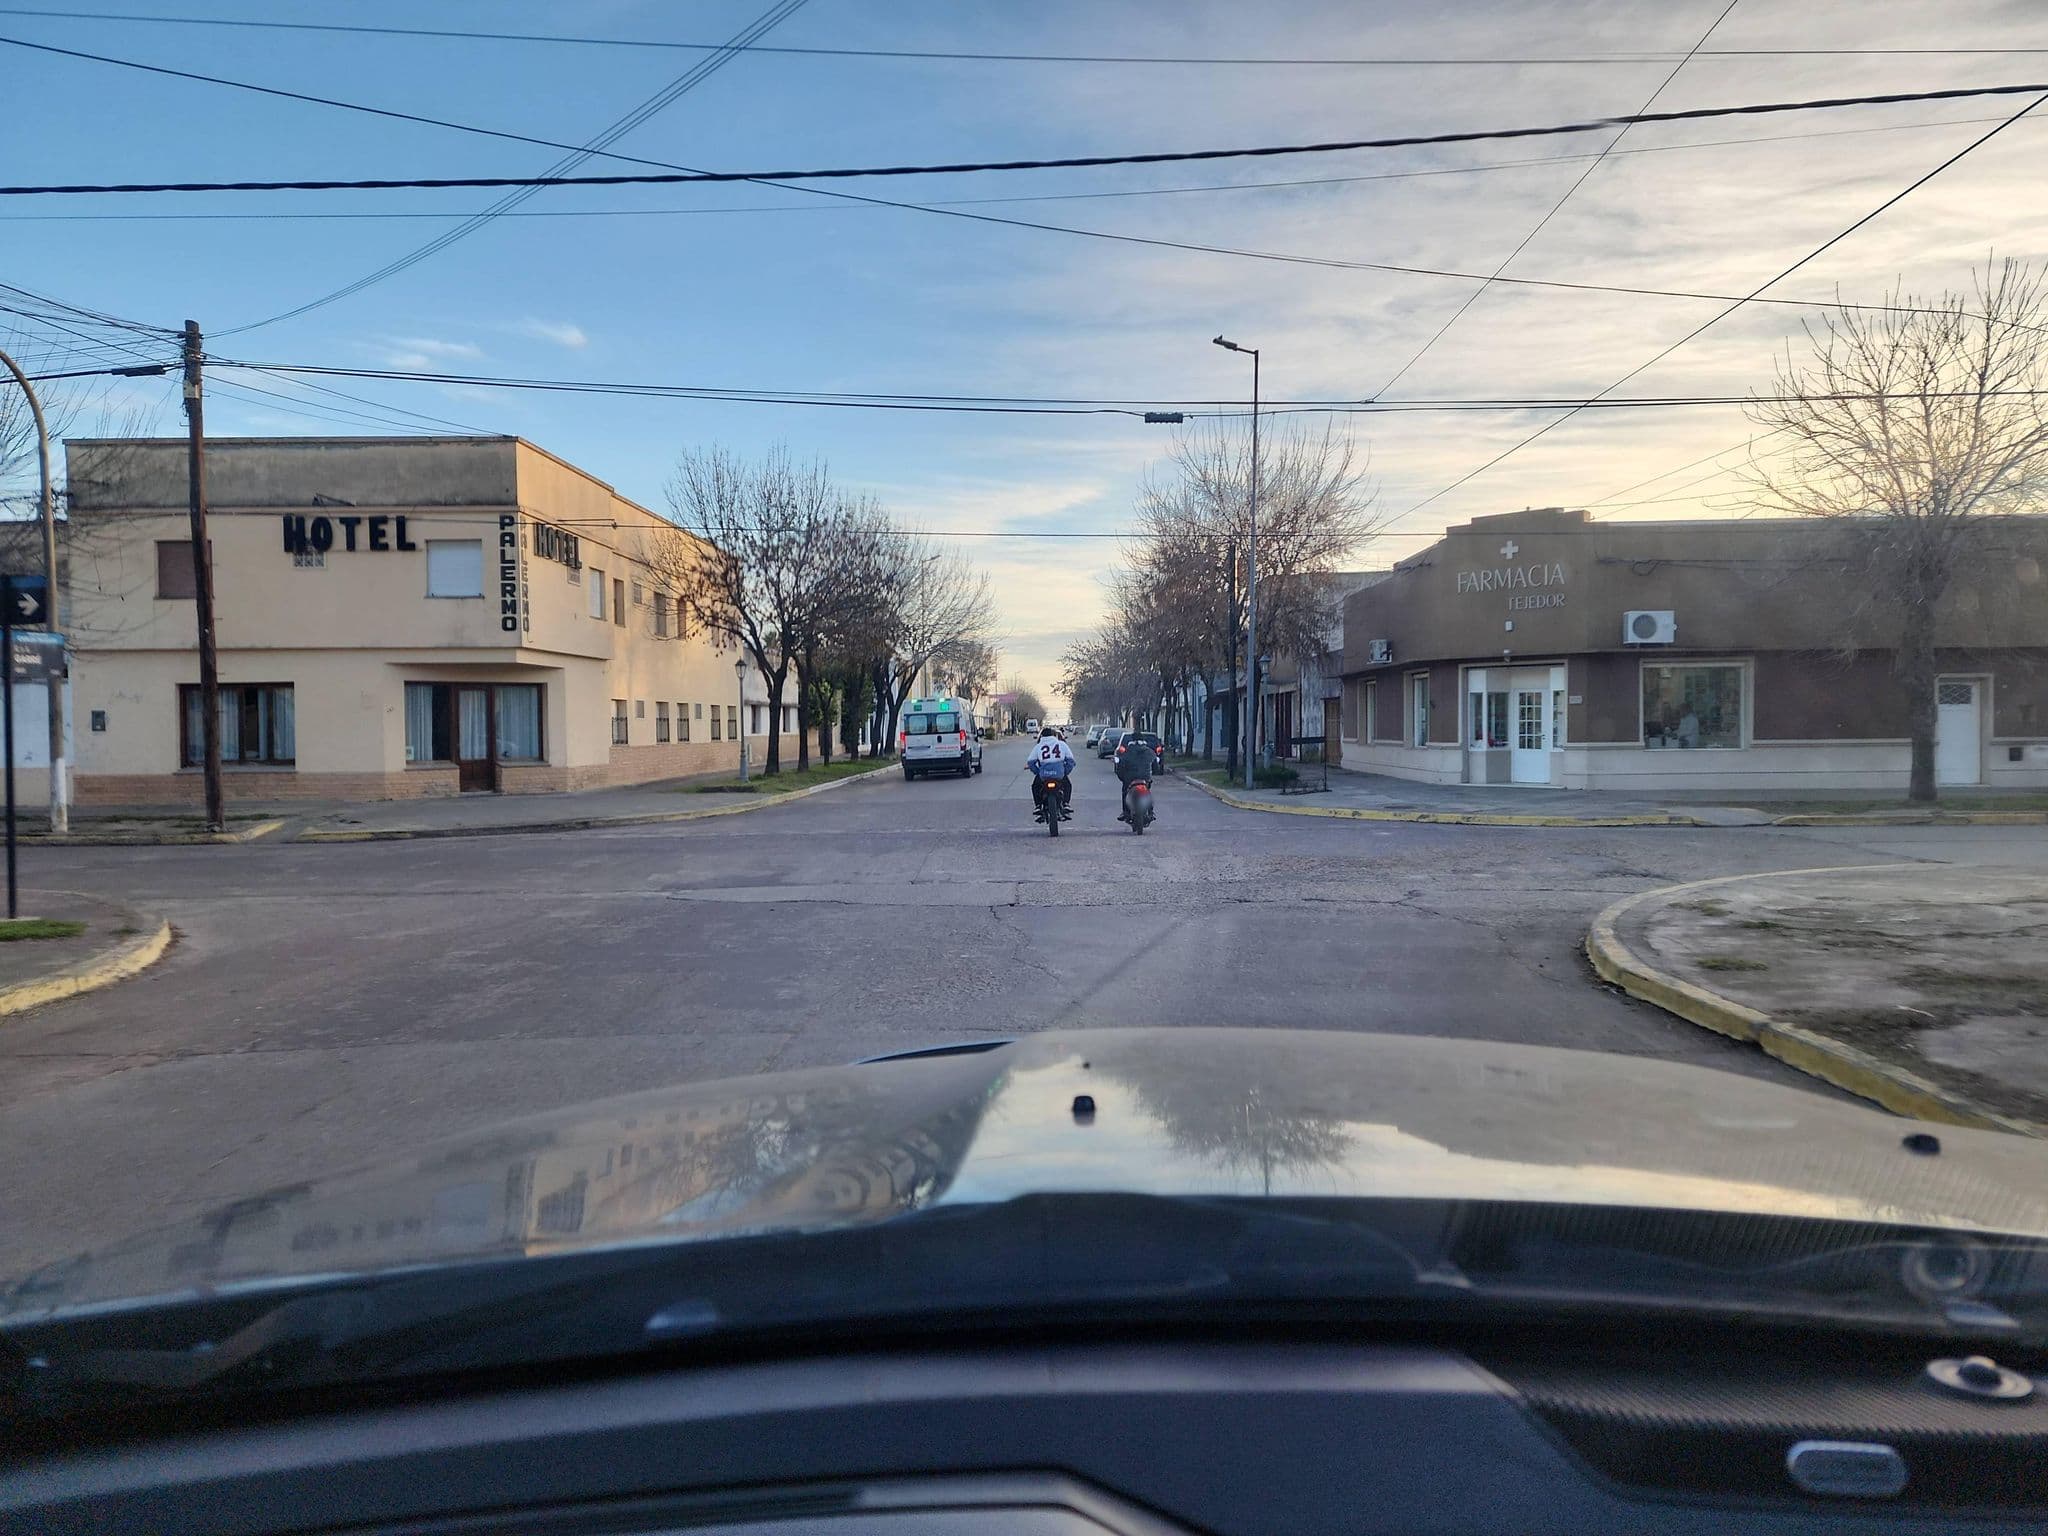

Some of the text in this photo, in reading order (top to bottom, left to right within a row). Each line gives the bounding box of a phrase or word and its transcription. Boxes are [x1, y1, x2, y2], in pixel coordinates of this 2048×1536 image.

[283, 514, 416, 553] HOTEL
[534, 522, 582, 570] HOTEL
[499, 514, 518, 632] PALERMO
[1457, 563, 1566, 594] FARMACIA
[1508, 594, 1566, 611] TEJEDOR
[1040, 743, 1061, 760] 24
